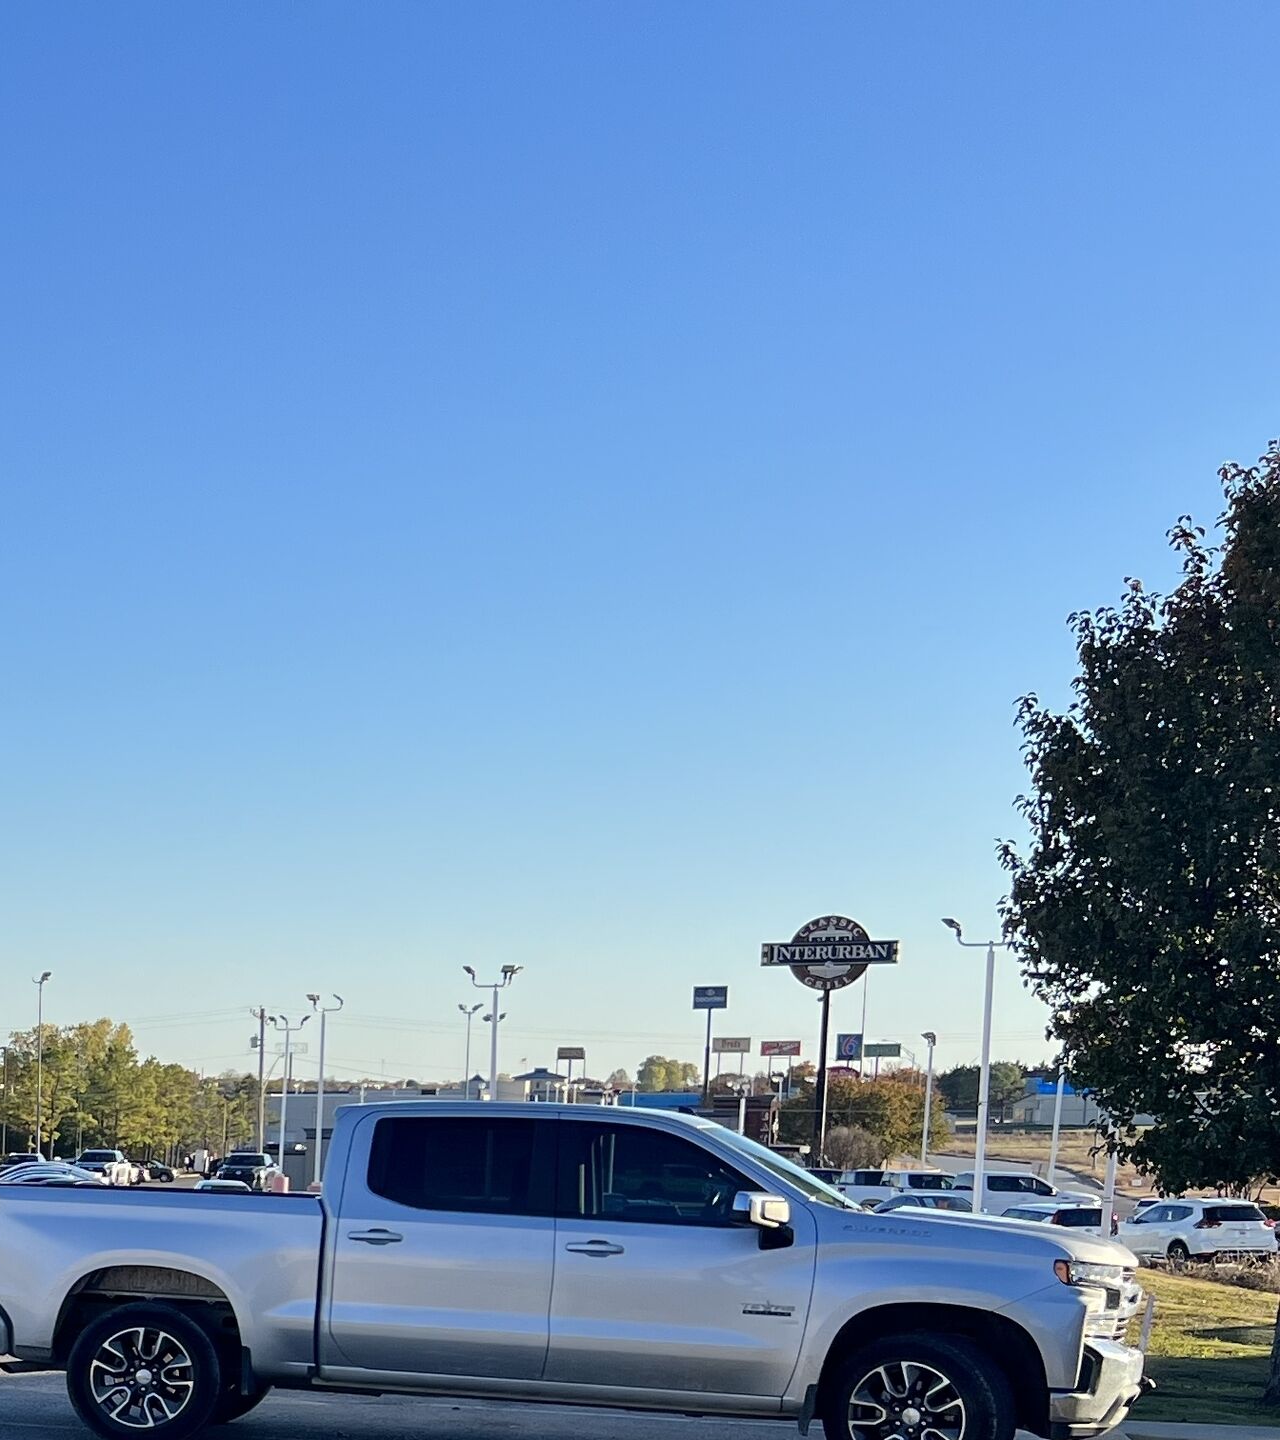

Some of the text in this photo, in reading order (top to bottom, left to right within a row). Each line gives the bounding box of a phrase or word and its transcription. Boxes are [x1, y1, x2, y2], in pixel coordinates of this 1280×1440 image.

[799, 917, 863, 937] CLASSIC
[771, 943, 889, 963] INTERURBAN
[804, 976, 852, 990] GRILL
